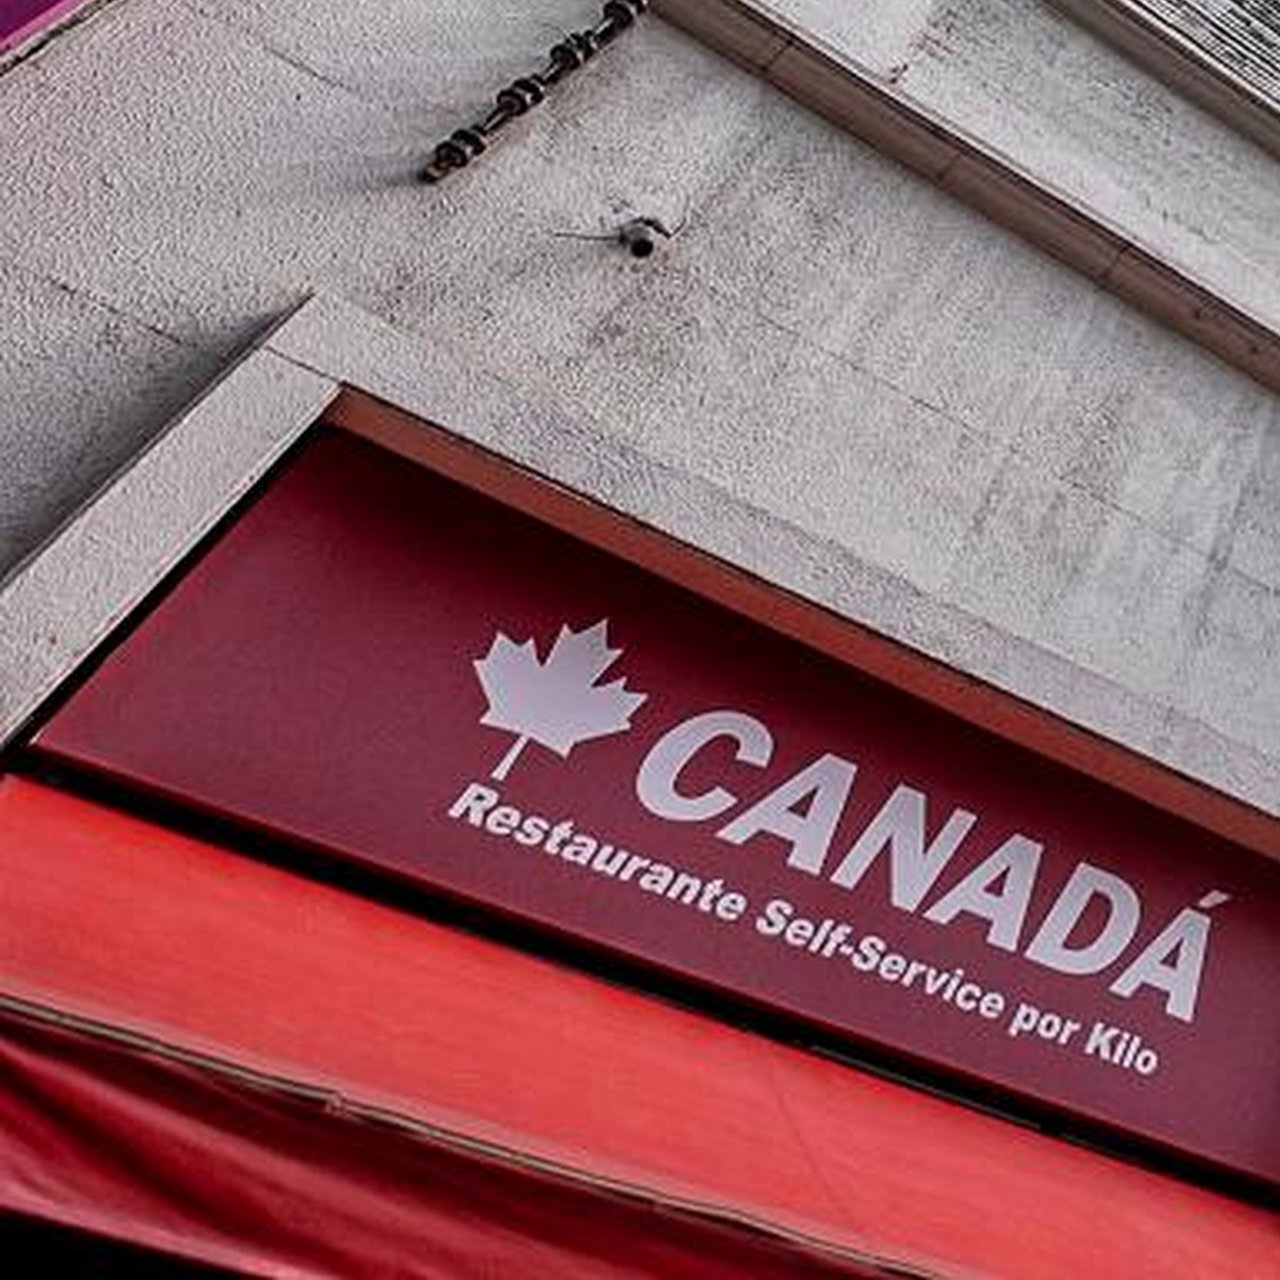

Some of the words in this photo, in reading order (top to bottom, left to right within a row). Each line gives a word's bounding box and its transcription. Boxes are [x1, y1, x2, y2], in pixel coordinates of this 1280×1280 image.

[447, 782, 748, 922] Restaurante
[755, 899, 1005, 1019] Self-Service
[1008, 1002, 1082, 1045] por
[1084, 1020, 1158, 1075] Kilo
[636, 710, 1229, 1023] CANADÁ
